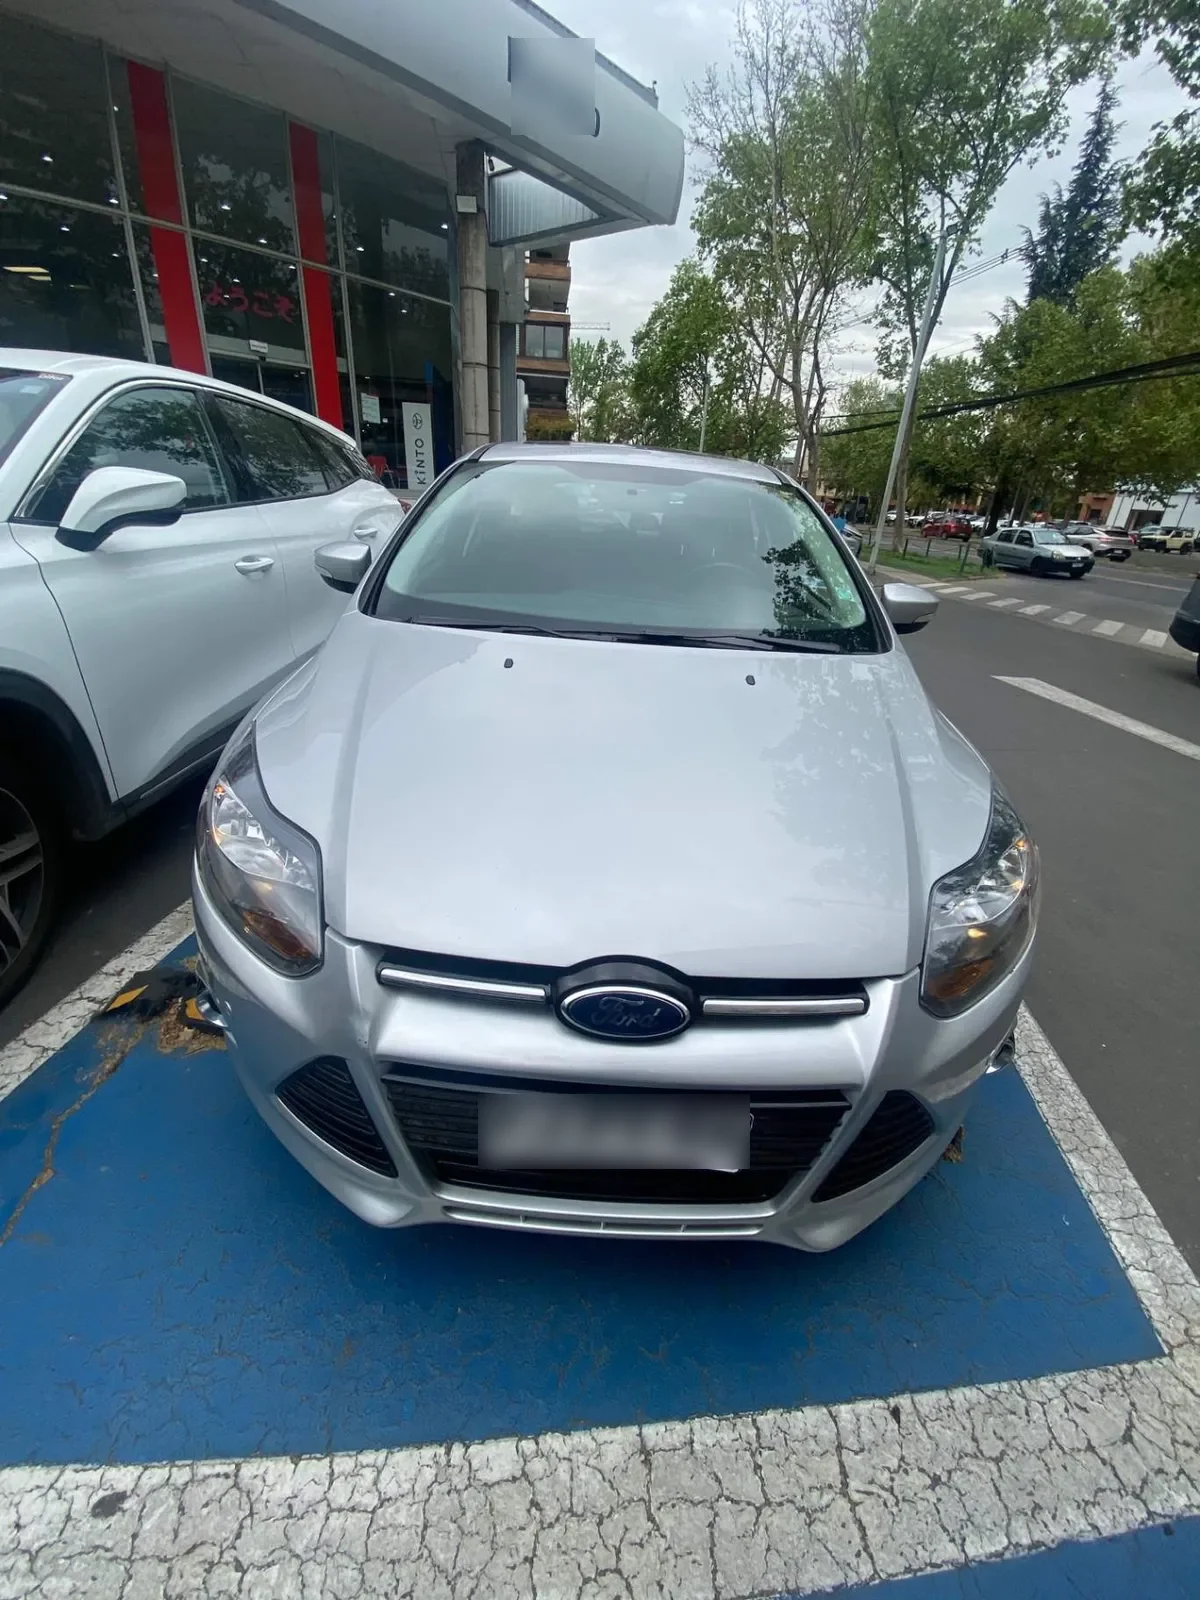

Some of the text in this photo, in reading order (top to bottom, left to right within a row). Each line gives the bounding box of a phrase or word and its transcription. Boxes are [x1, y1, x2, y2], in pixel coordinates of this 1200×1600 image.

[204, 281, 295, 323] ようこそ
[591, 996, 660, 1028] Ford
